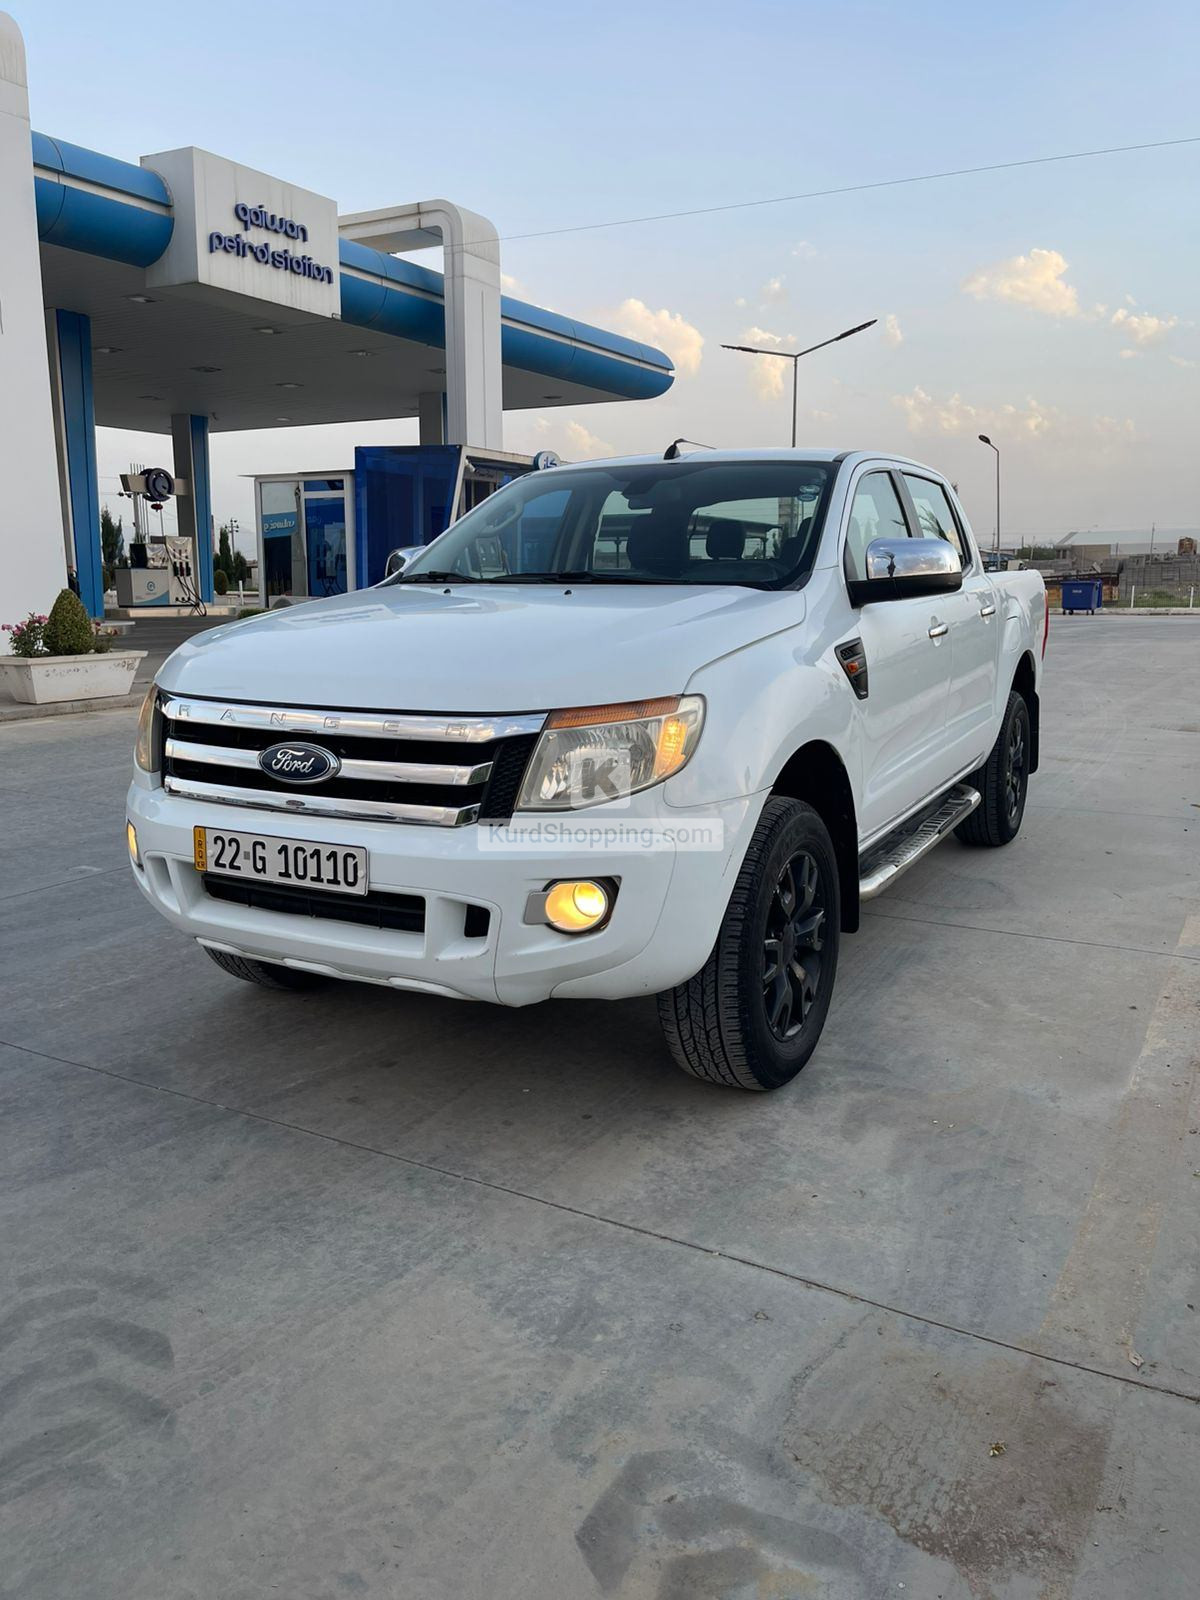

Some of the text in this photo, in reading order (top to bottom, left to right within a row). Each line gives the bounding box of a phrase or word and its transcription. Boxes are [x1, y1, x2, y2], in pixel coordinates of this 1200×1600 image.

[234, 203, 308, 242] qaiwan
[209, 231, 333, 284] petrol station
[178, 704, 468, 738] RANGER
[271, 748, 315, 774] Ford
[277, 844, 359, 887] 10110
